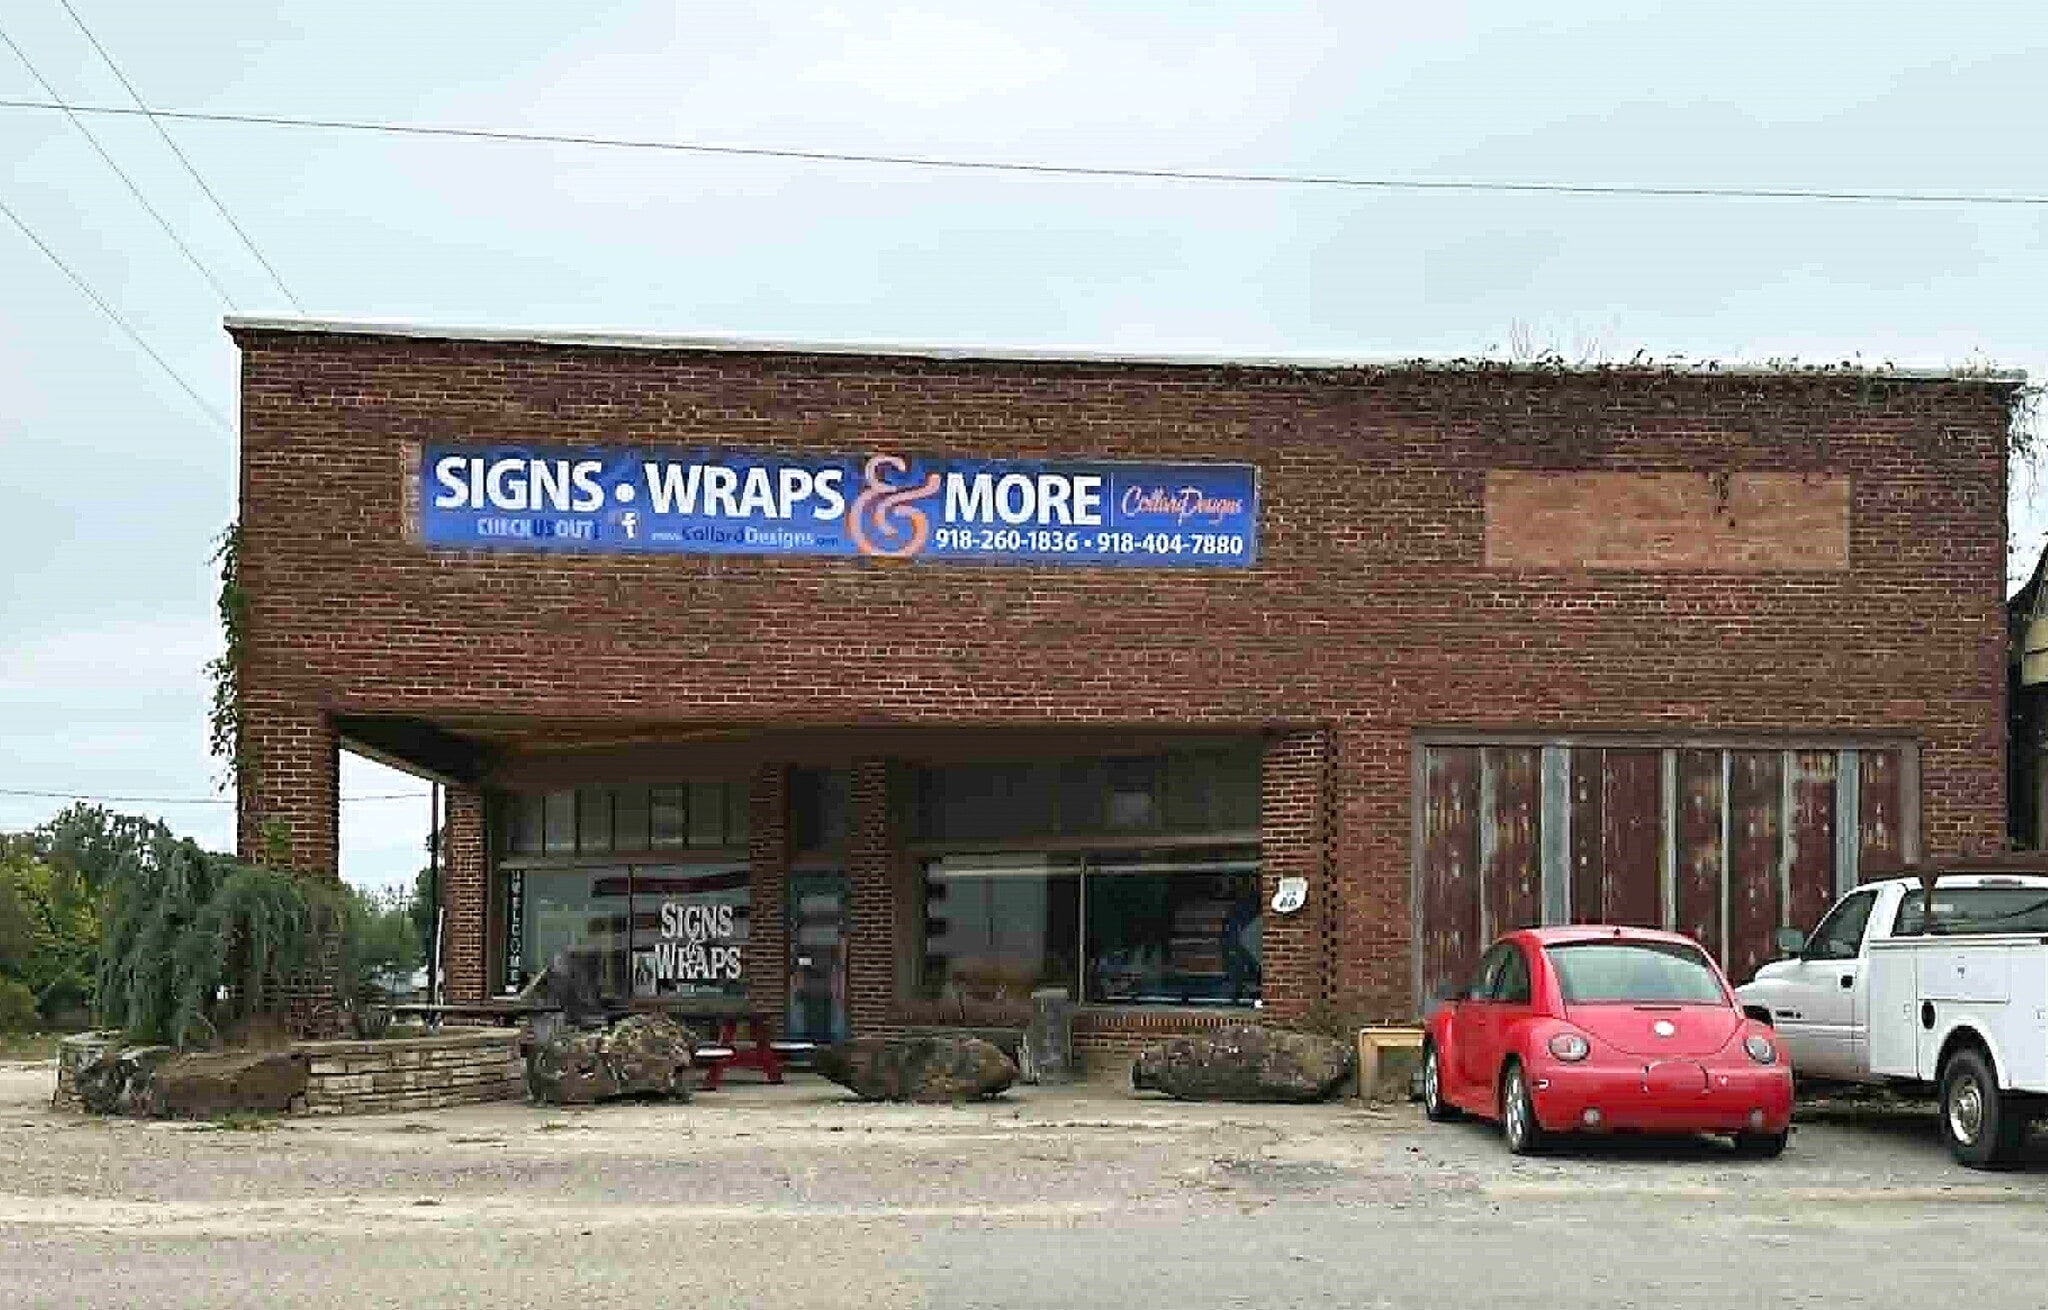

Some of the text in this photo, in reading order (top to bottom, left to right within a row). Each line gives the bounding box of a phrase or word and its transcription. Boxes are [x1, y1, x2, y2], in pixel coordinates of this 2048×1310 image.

[435, 455, 1103, 557] SIGNS WRAPS & MORE
[936, 527, 1243, 556] 918-260-1836 918-404-7880
[661, 902, 734, 938] SIGNS
[655, 942, 742, 979] WRAPS
